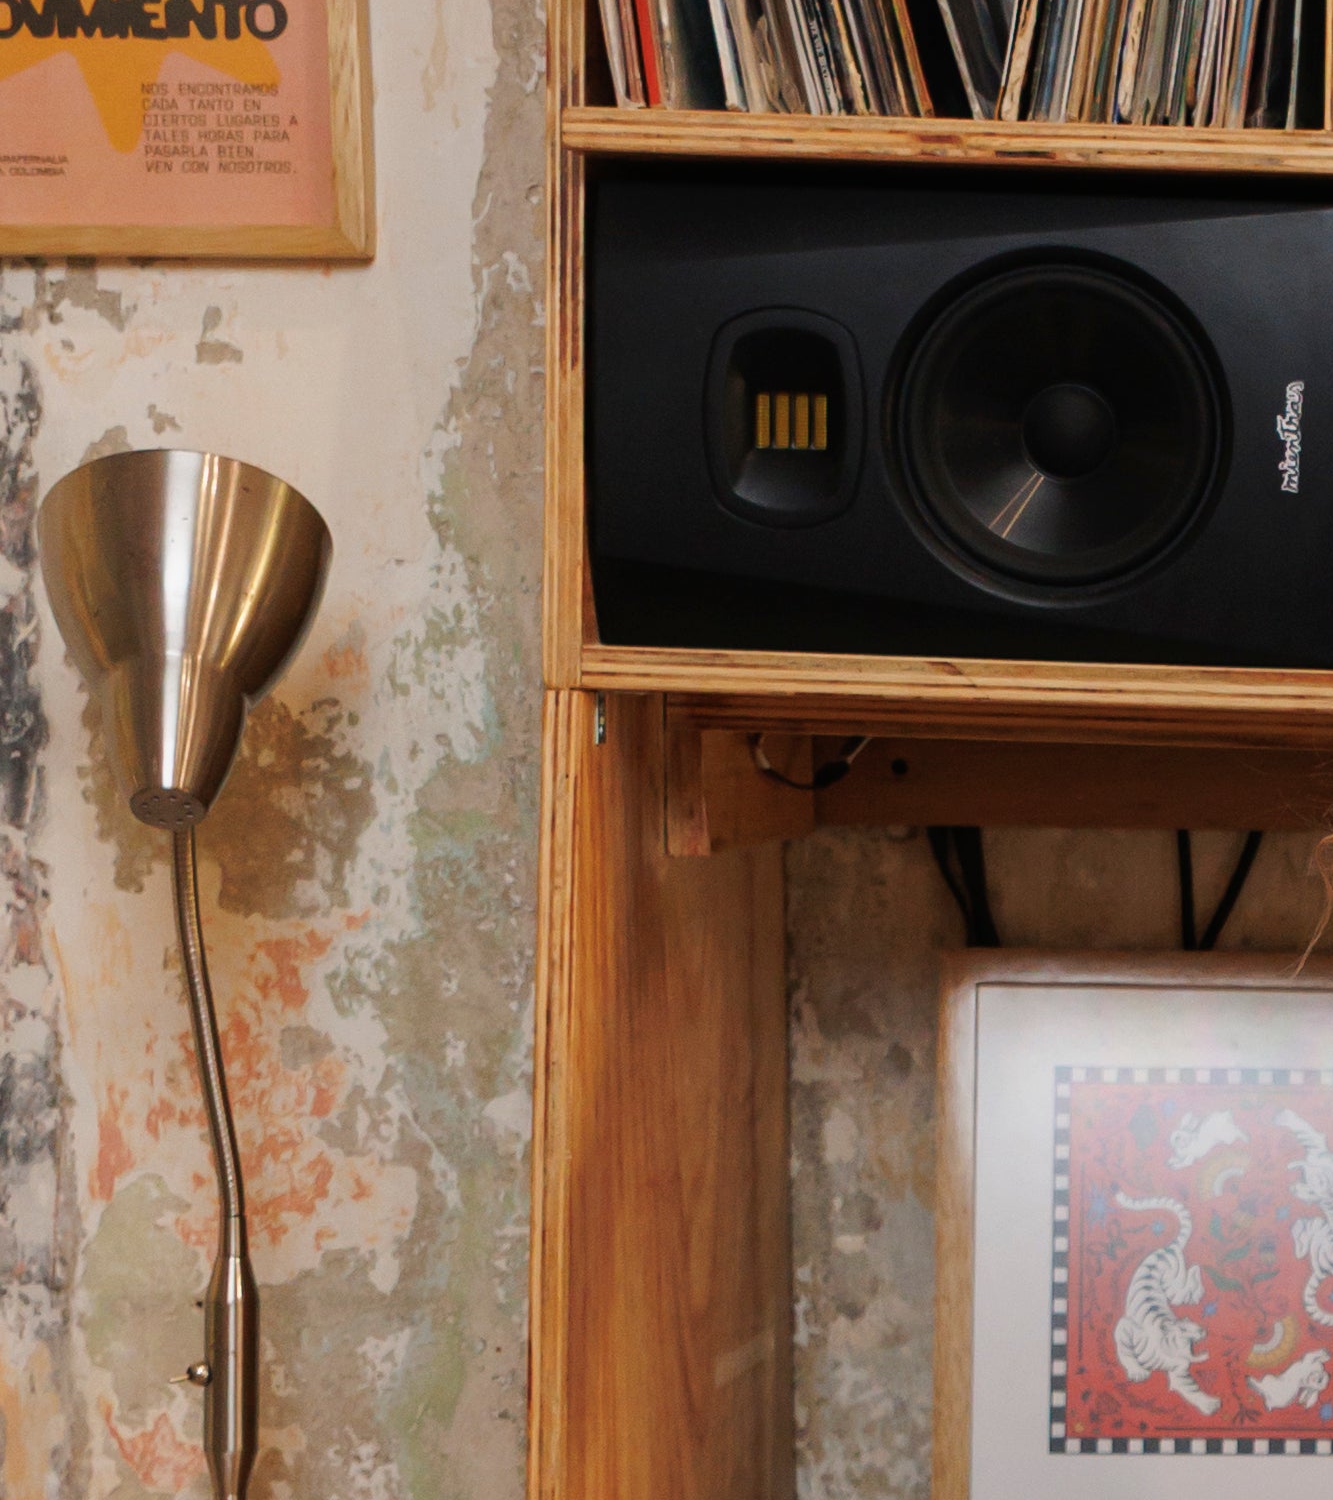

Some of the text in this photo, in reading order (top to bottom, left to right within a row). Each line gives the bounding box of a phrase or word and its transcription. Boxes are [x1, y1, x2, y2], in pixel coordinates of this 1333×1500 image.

[178, 83, 279, 97] ENCONTRAMOS
[142, 98, 261, 112] CADA TANTO EN
[142, 114, 298, 128] CIERTOS LUGARES A
[144, 129, 190, 143] TALES
[254, 129, 290, 143] PARA
[145, 160, 173, 174] VEN
[181, 160, 209, 174] CON
